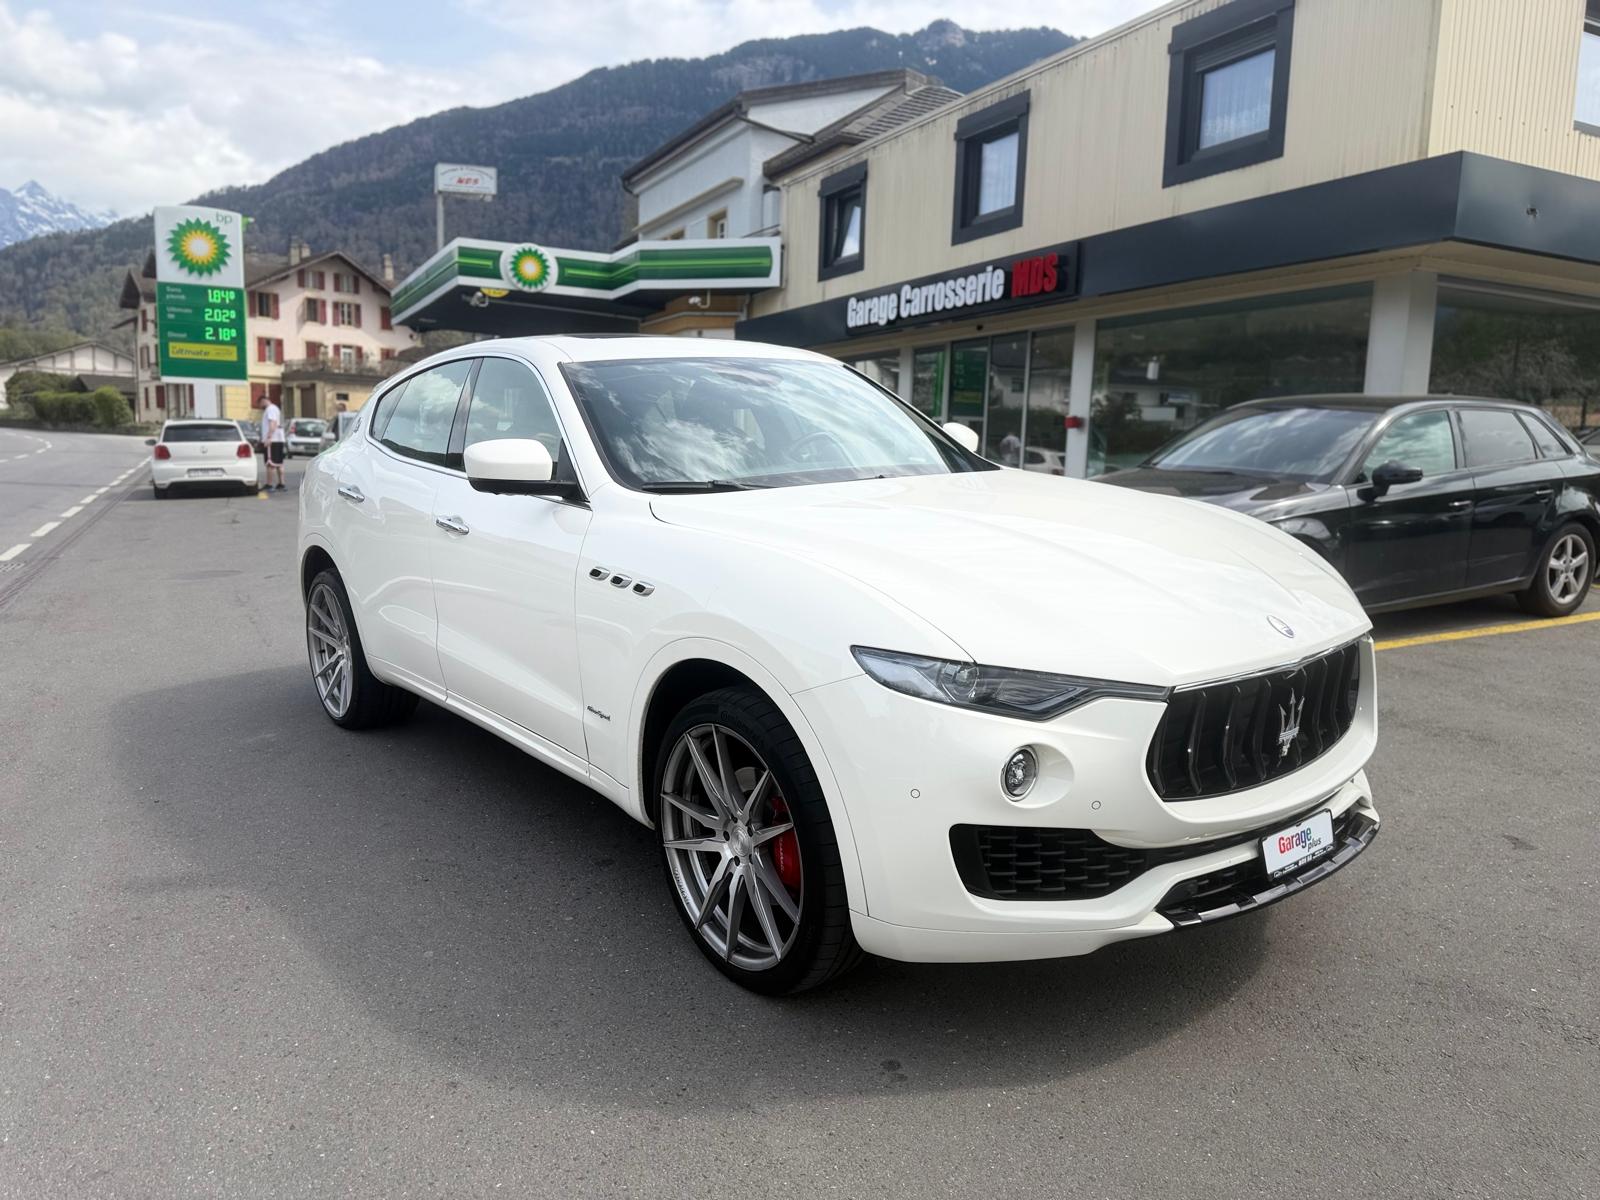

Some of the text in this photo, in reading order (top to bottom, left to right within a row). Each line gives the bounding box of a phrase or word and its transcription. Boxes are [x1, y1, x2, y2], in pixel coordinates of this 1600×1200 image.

[216, 212, 233, 225] bp
[846, 252, 1058, 328] Garage Carrosserie MDS
[1278, 827, 1312, 854] Garage
[1307, 838, 1322, 852] plus
